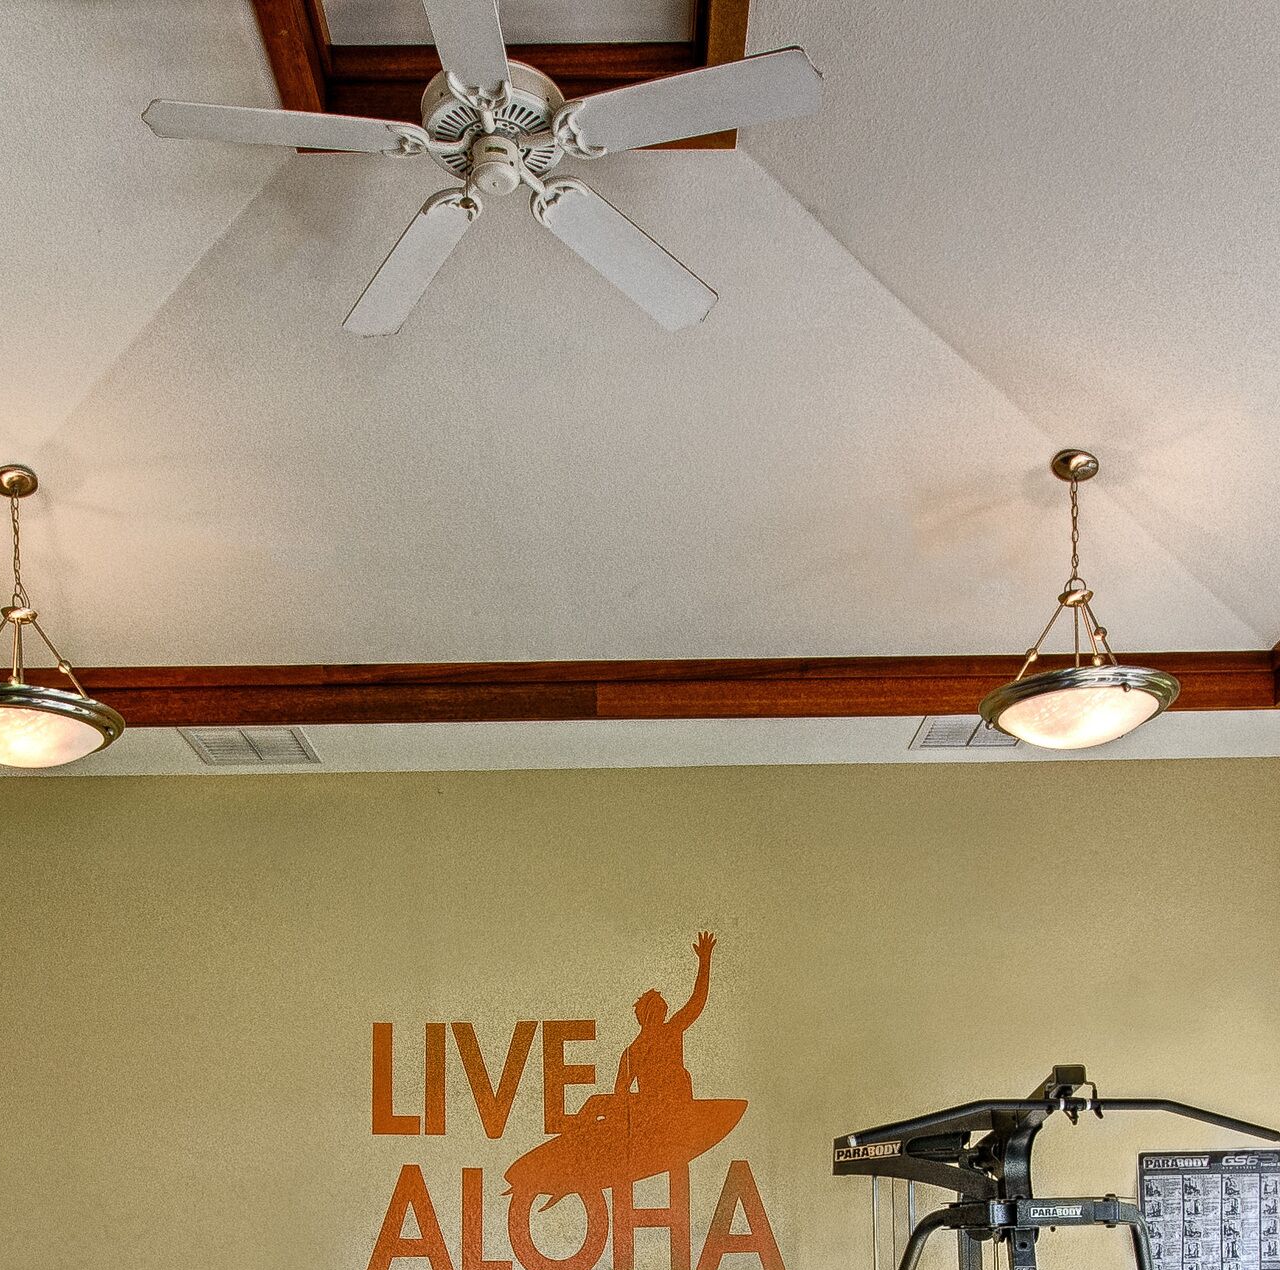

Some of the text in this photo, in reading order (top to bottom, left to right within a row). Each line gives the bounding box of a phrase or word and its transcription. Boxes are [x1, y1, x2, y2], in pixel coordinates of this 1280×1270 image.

[372, 1020, 596, 1138] LIVE
[835, 1142, 901, 1161] PARABODY
[1144, 1157, 1210, 1169] PARABODY
[1221, 1155, 1259, 1166] GS6
[1031, 1206, 1082, 1217] PARABODY
